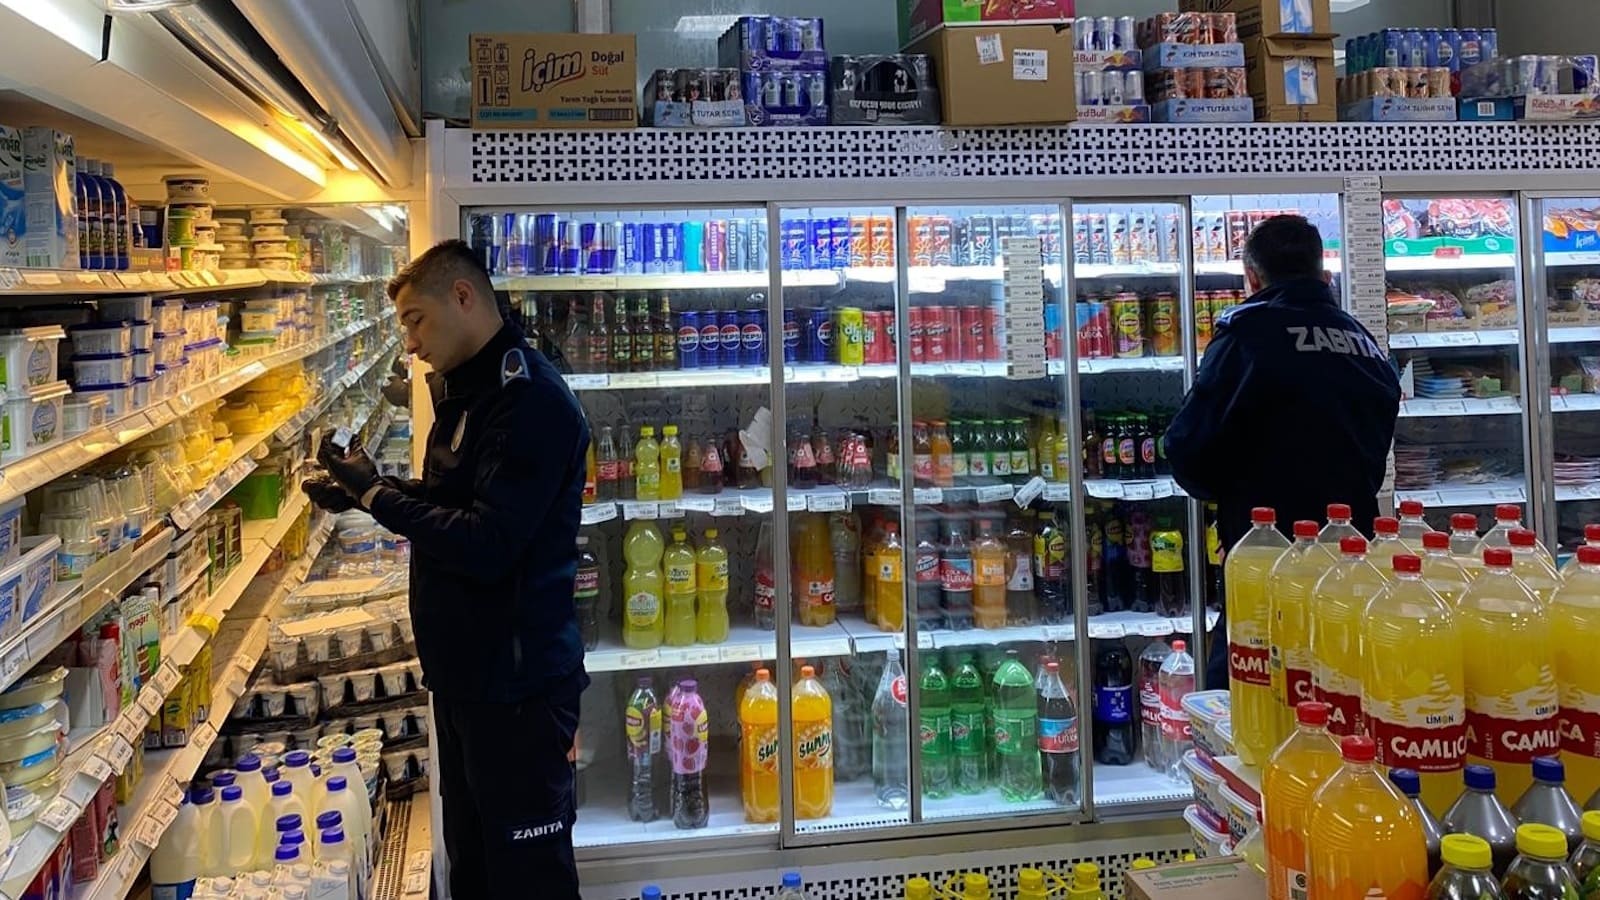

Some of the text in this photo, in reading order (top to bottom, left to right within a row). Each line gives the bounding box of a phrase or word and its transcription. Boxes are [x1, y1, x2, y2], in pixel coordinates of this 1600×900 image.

[591, 51, 624, 64] Doğal
[521, 48, 582, 93] İçim
[592, 65, 608, 76] Süt
[512, 820, 564, 840] ZABITA
